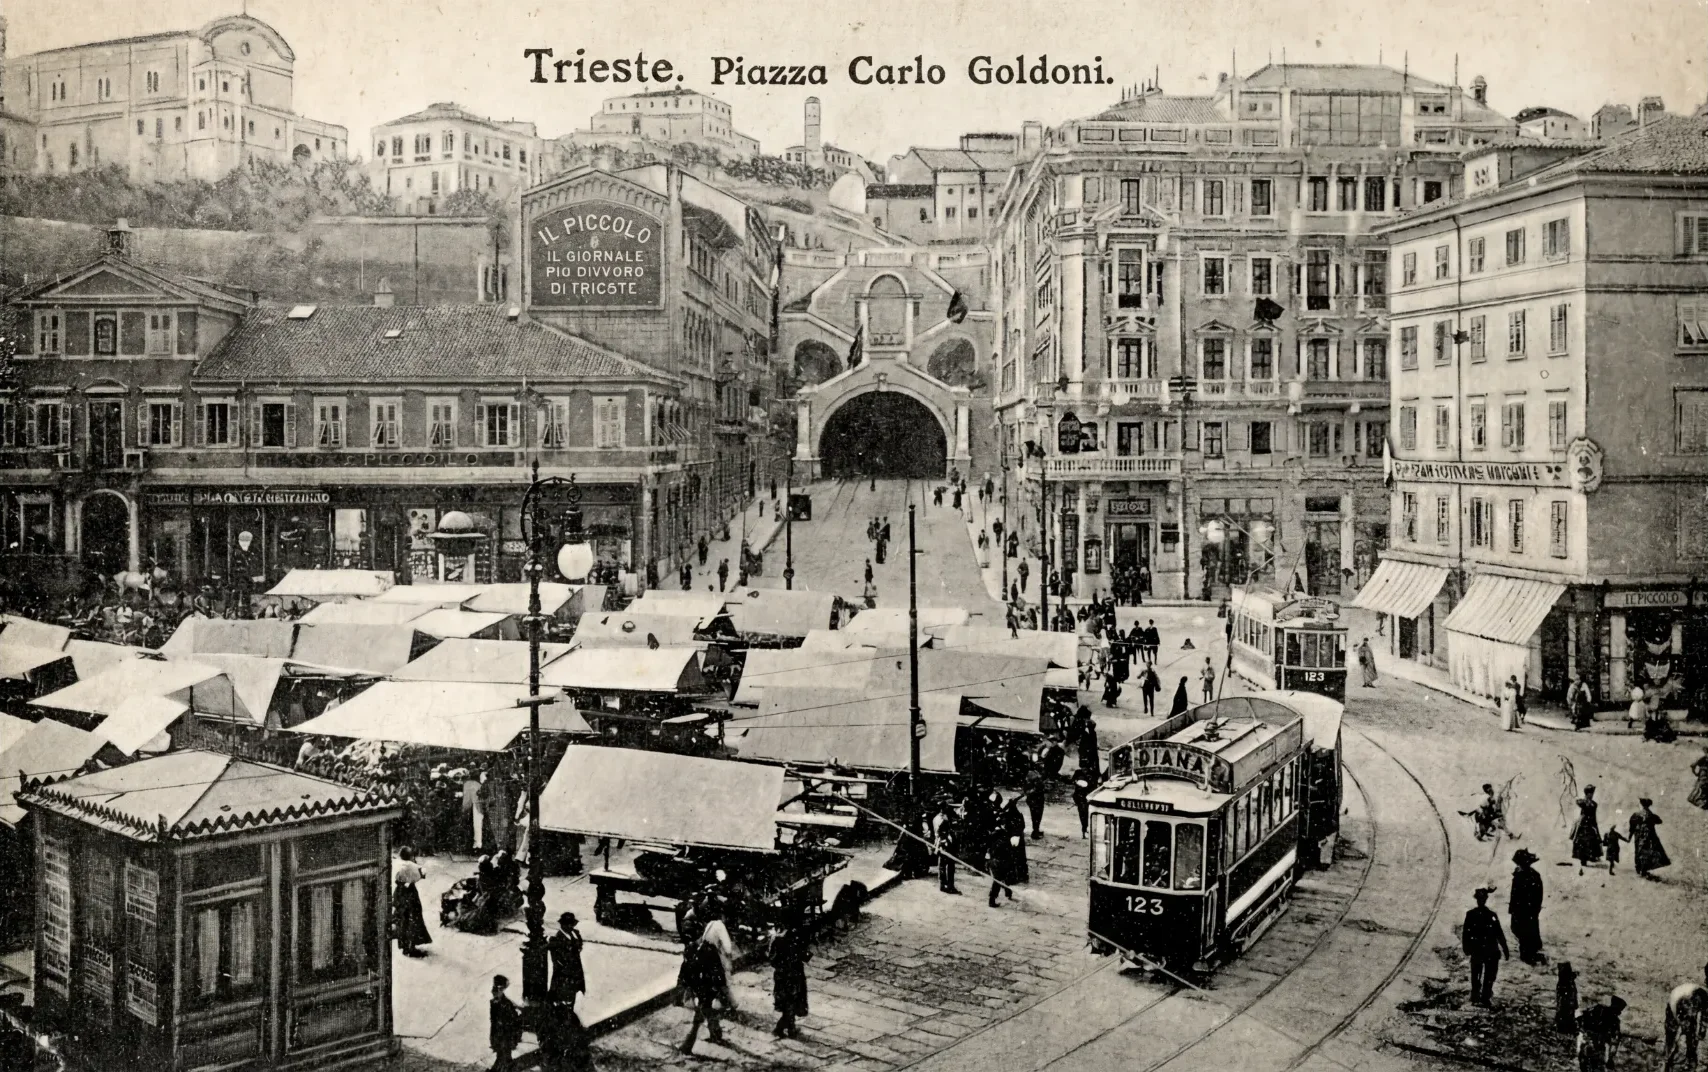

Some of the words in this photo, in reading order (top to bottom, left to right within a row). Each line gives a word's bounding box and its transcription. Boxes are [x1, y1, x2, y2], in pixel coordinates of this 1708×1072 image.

[538, 226, 560, 245] IL
[563, 213, 651, 244] PICCOLO
[547, 250, 561, 262] IL
[566, 250, 644, 262] GIORNALE
[577, 266, 644, 278] DIVVORO
[551, 282, 566, 295] DI
[1637, 592, 1679, 605] PICCOLO
[1304, 671, 1325, 682] 123
[1138, 748, 1205, 775] DIANA
[1125, 896, 1164, 915] 123
